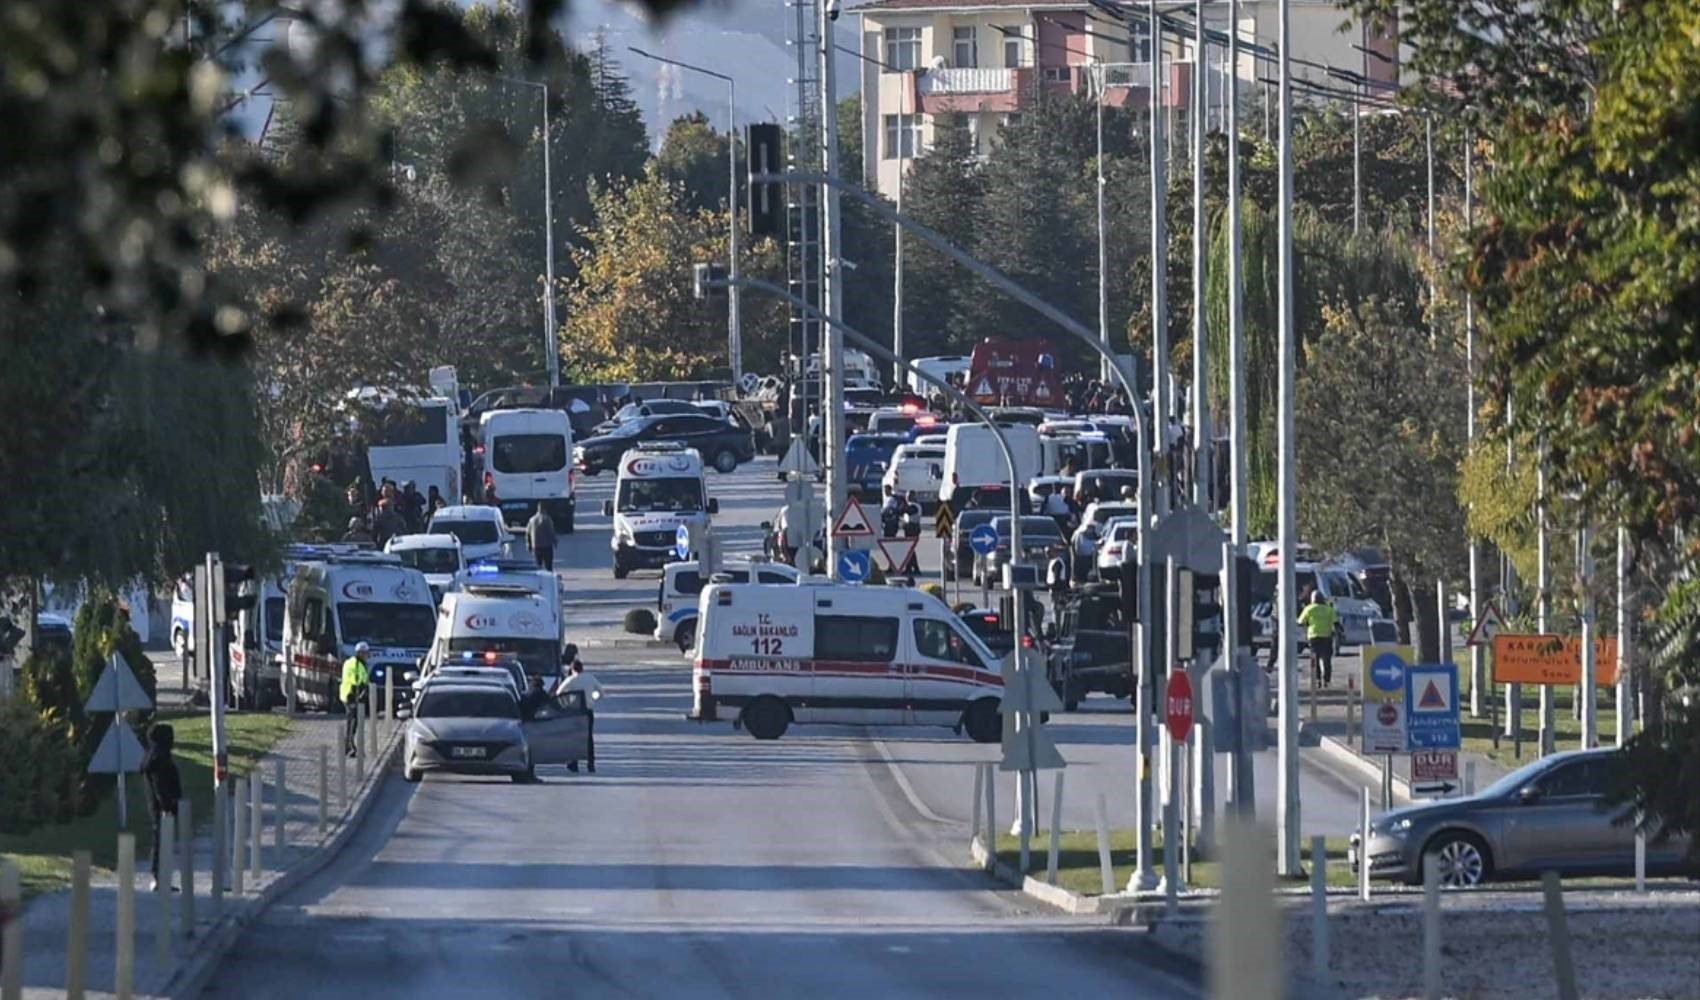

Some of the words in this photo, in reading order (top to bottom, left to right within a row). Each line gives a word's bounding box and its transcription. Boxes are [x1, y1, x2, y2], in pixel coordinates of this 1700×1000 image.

[751, 638, 783, 655] 112
[729, 659, 800, 671] AMBULANS
[1168, 696, 1191, 716] DUR
[1415, 754, 1453, 765] DUR
